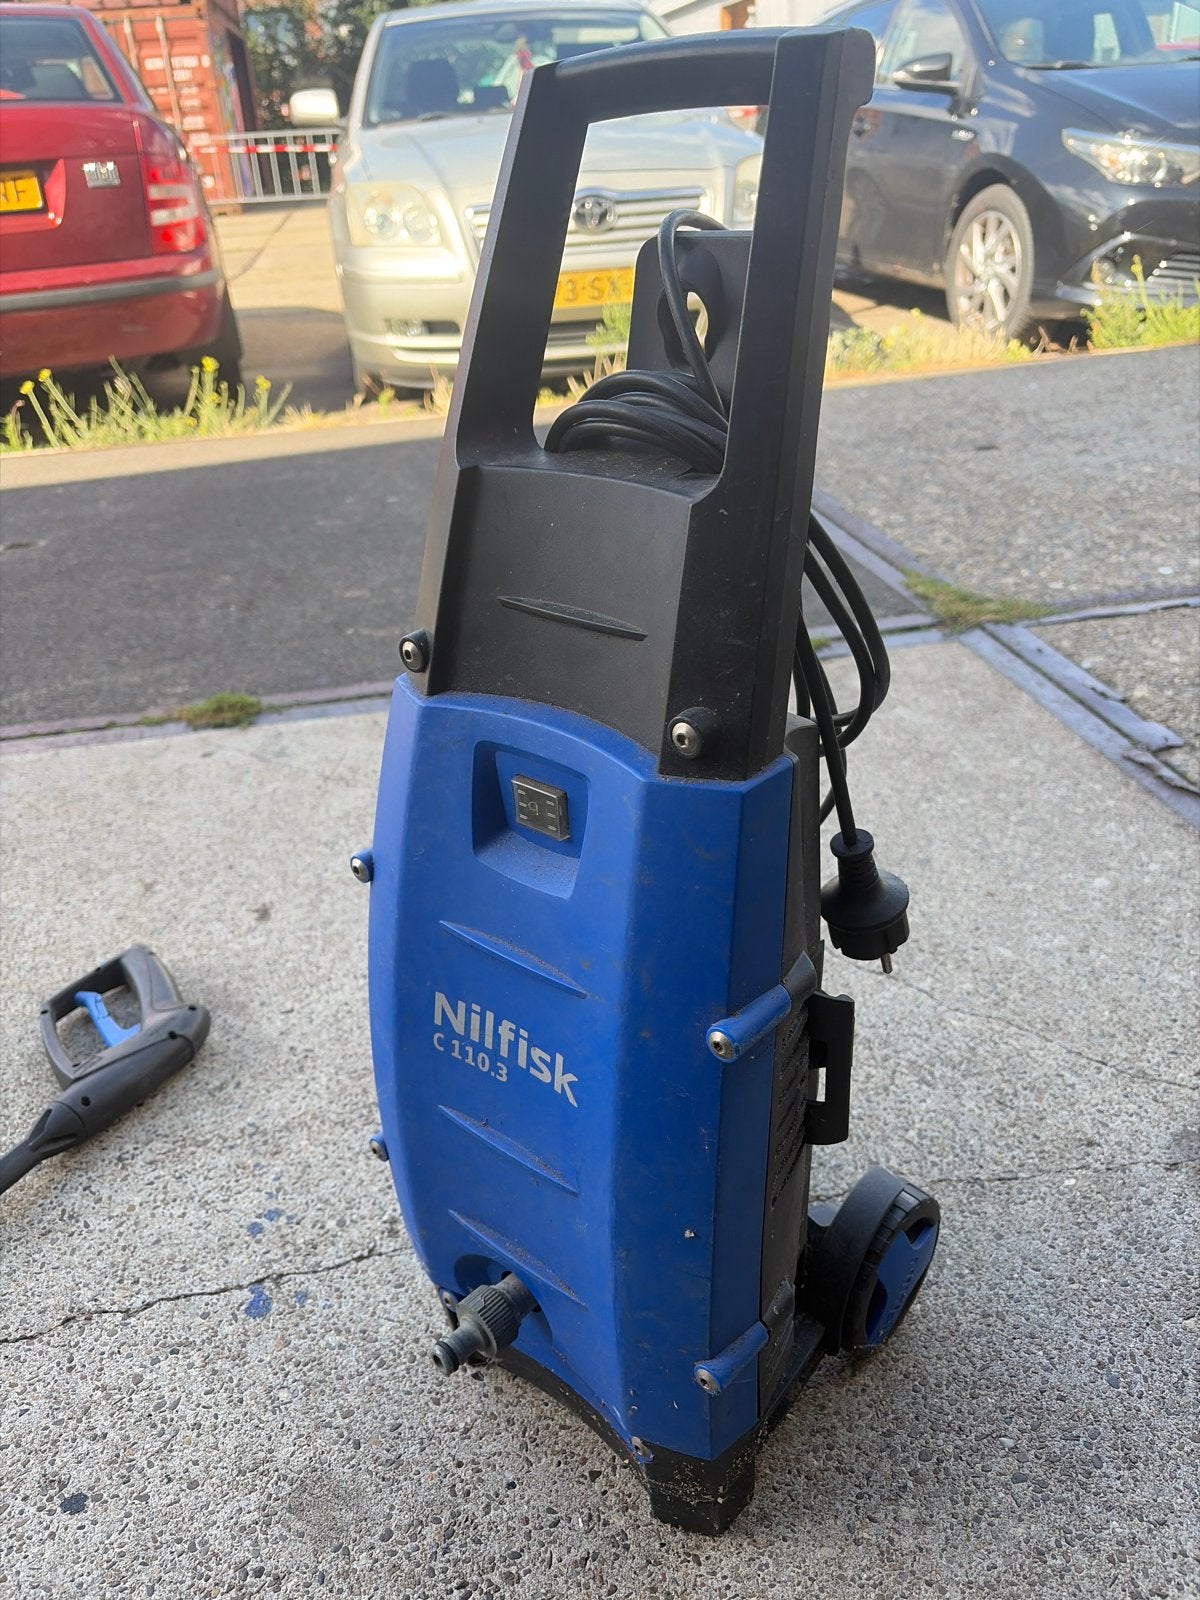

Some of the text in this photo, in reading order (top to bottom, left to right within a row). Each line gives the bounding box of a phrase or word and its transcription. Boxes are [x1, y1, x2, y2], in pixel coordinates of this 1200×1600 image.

[433, 1032, 508, 1082] C 110.3
[434, 991, 579, 1108] Nilfisk
